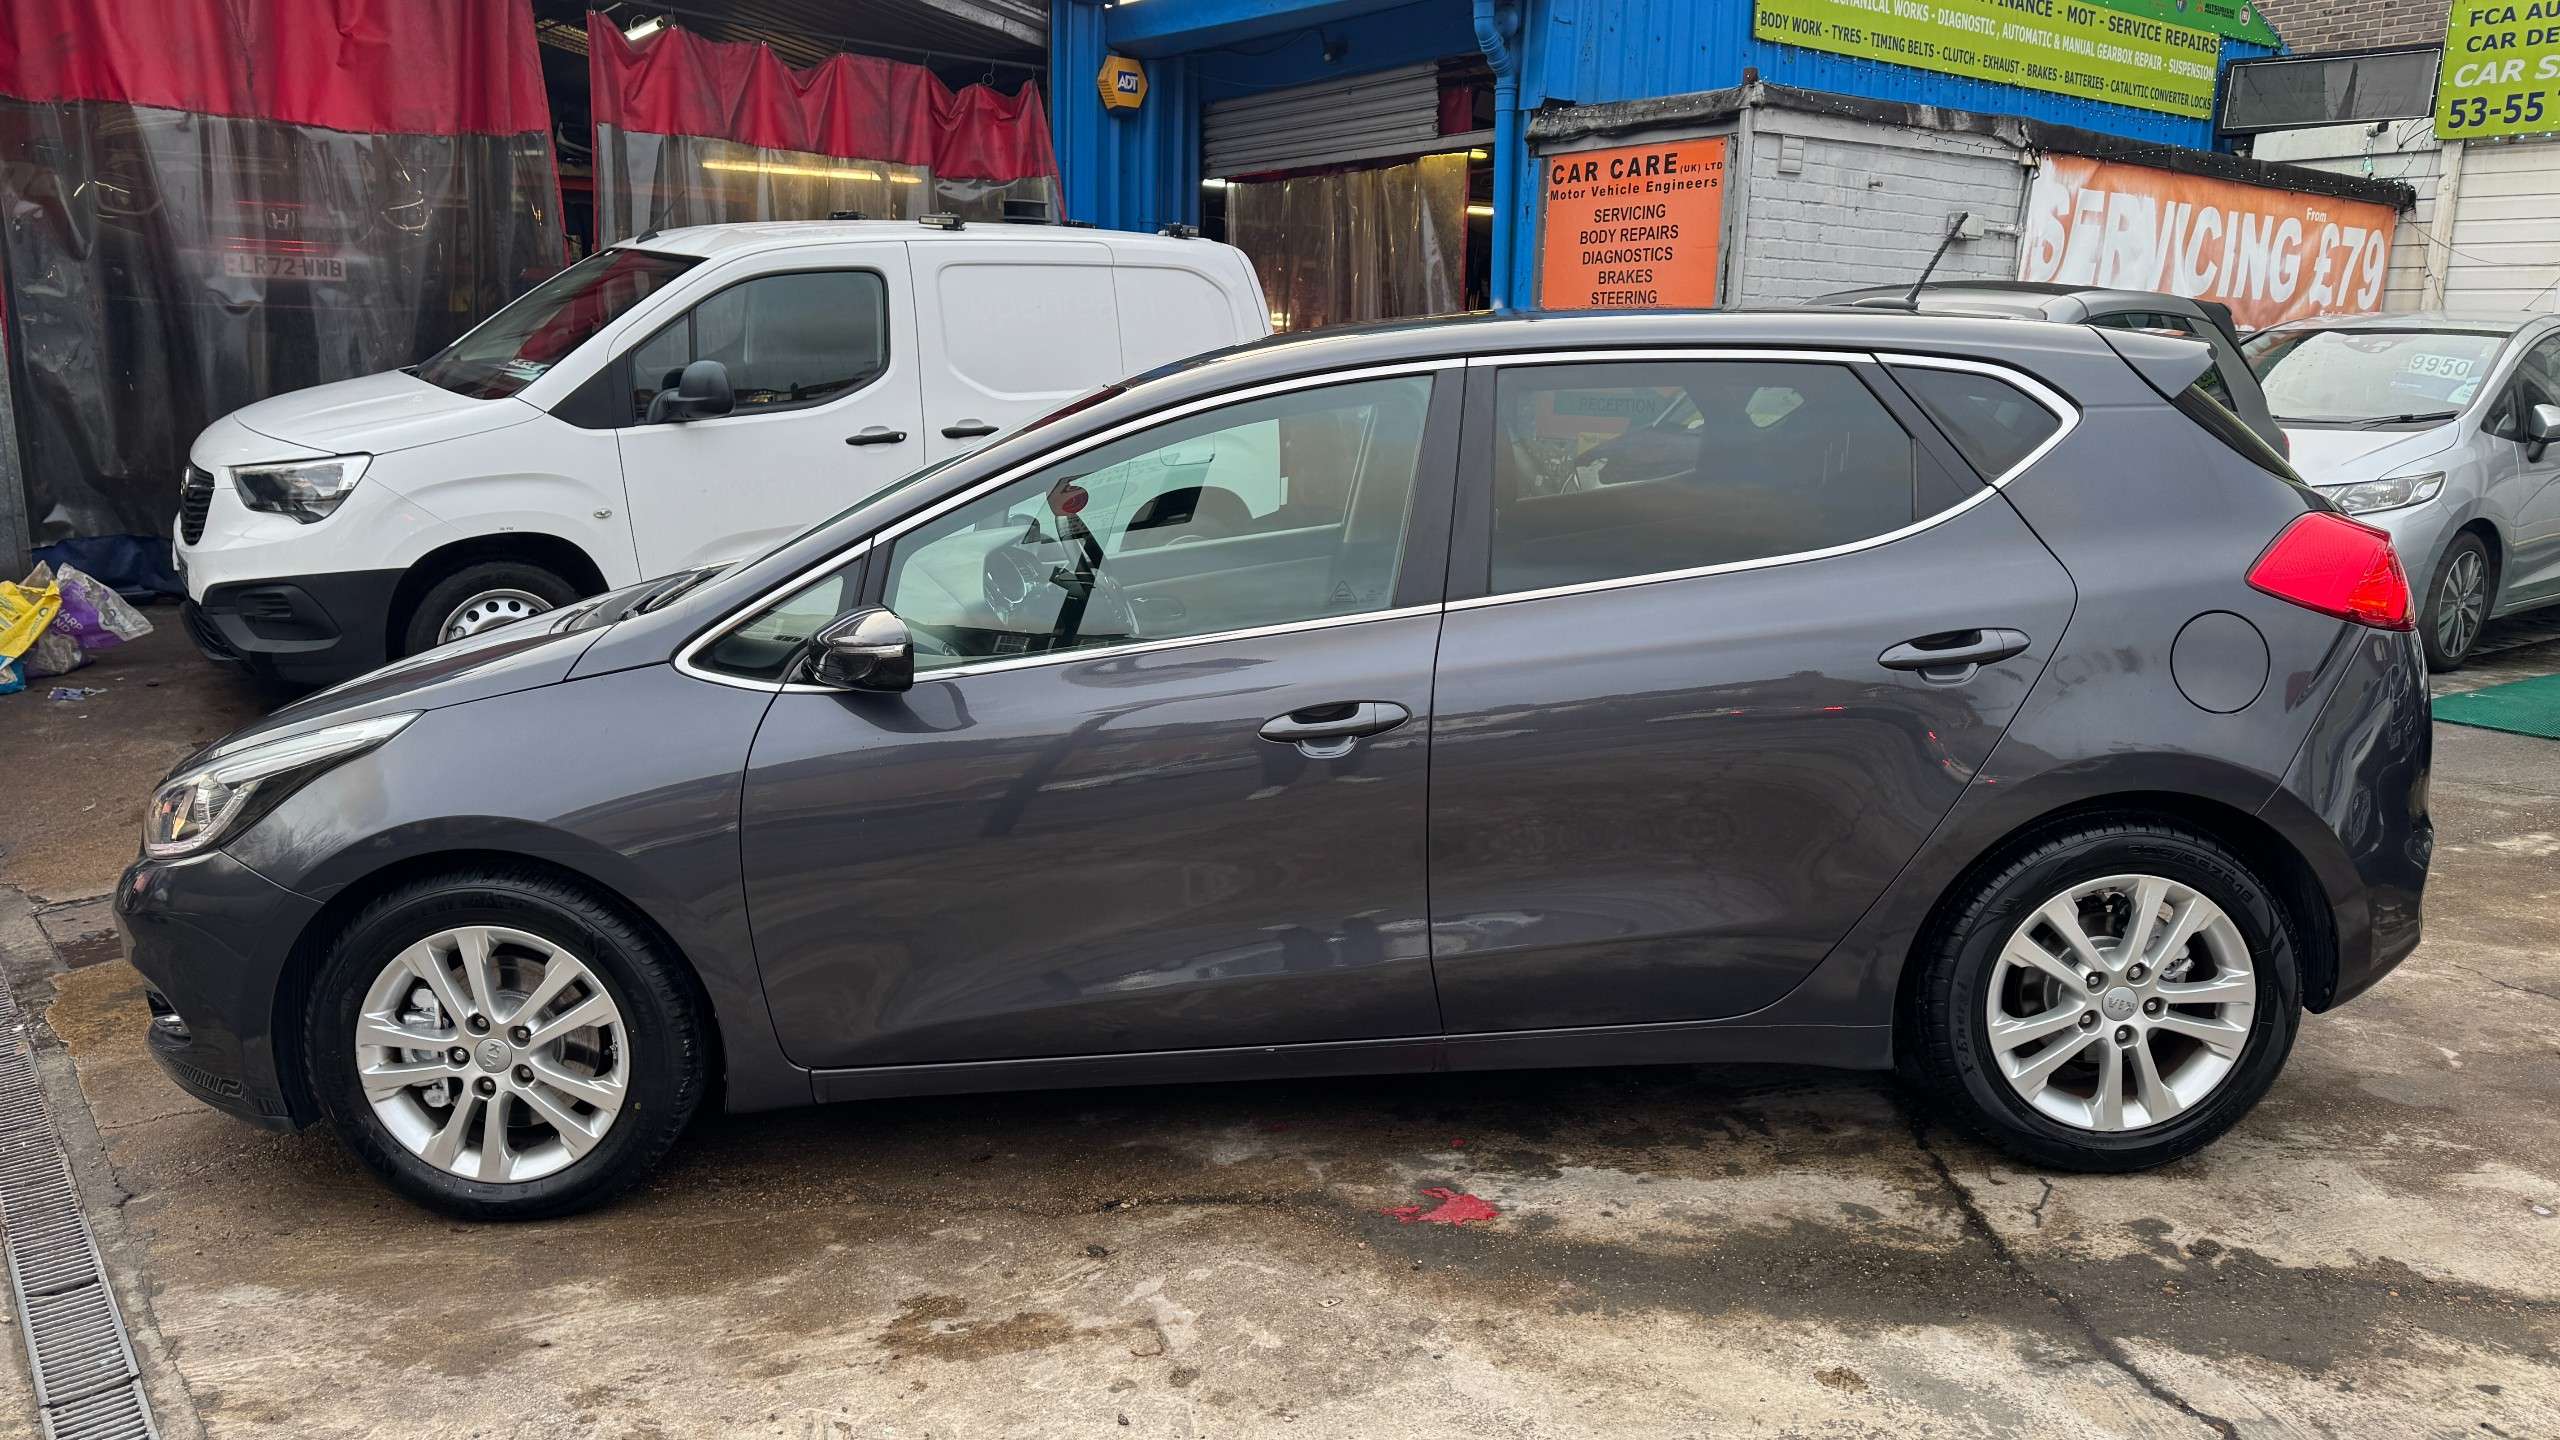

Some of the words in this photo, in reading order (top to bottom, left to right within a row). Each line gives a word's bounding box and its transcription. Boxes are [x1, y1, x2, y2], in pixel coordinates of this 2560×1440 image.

[2470, 6, 2517, 27] FCA
[2067, 6, 2096, 27] MOT
[2108, 15, 2161, 42] SERVICE
[2165, 30, 2217, 54] REPAIRS
[1893, 2, 1929, 22] WORKS
[1937, 8, 1995, 35] DIAGNOSTIC
[2002, 23, 2053, 49] AUTOMATIC
[2053, 38, 2060, 49] &
[2062, 36, 2095, 57] MANUAL
[2097, 43, 2133, 65] GEARBOX
[2134, 52, 2162, 70] REPAIR
[2168, 58, 2214, 81] SUSPENSION
[2466, 32, 2517, 53] CAR
[1760, 11, 1789, 30] BODY
[1792, 17, 1822, 37] WORK
[1832, 24, 1862, 44] TYRES
[1871, 32, 1905, 53] TIMING
[1907, 39, 1935, 58] BELTS
[1942, 46, 1976, 66] CLUTCH
[1983, 54, 2020, 75] EXHAUST
[2027, 63, 2058, 82] BRAKES
[2064, 71, 2104, 91] BATTERIES
[2110, 80, 2149, 99] CATALYTIC
[2150, 87, 2189, 106] CONVERTER
[2190, 94, 2212, 111] LOCKS
[2454, 59, 2526, 88] CAR
[2534, 54, 2560, 79] S
[1117, 74, 1138, 91] ADT
[2447, 92, 2545, 128] 53-55
[1551, 161, 1599, 185] CAR
[1610, 153, 1679, 179] CARE
[1680, 163, 1701, 174] (UK)
[1705, 161, 1723, 171] LTD
[1550, 189, 1586, 201] Motor
[1591, 184, 1640, 198] Vehicle
[1646, 178, 1718, 194] Engineers
[1593, 204, 1666, 223] SERVICING
[2306, 207, 2328, 222] From
[1579, 229, 1617, 245] BODY
[1620, 225, 1679, 242] REPAIRS
[2028, 180, 2303, 303] SERVICING
[1582, 247, 1673, 265] DIAGNOSTICS
[1598, 269, 1653, 284] BRAKES
[2309, 223, 2385, 311] £79
[1590, 290, 1658, 305] STEERING
[2410, 355, 2470, 376] 9950
